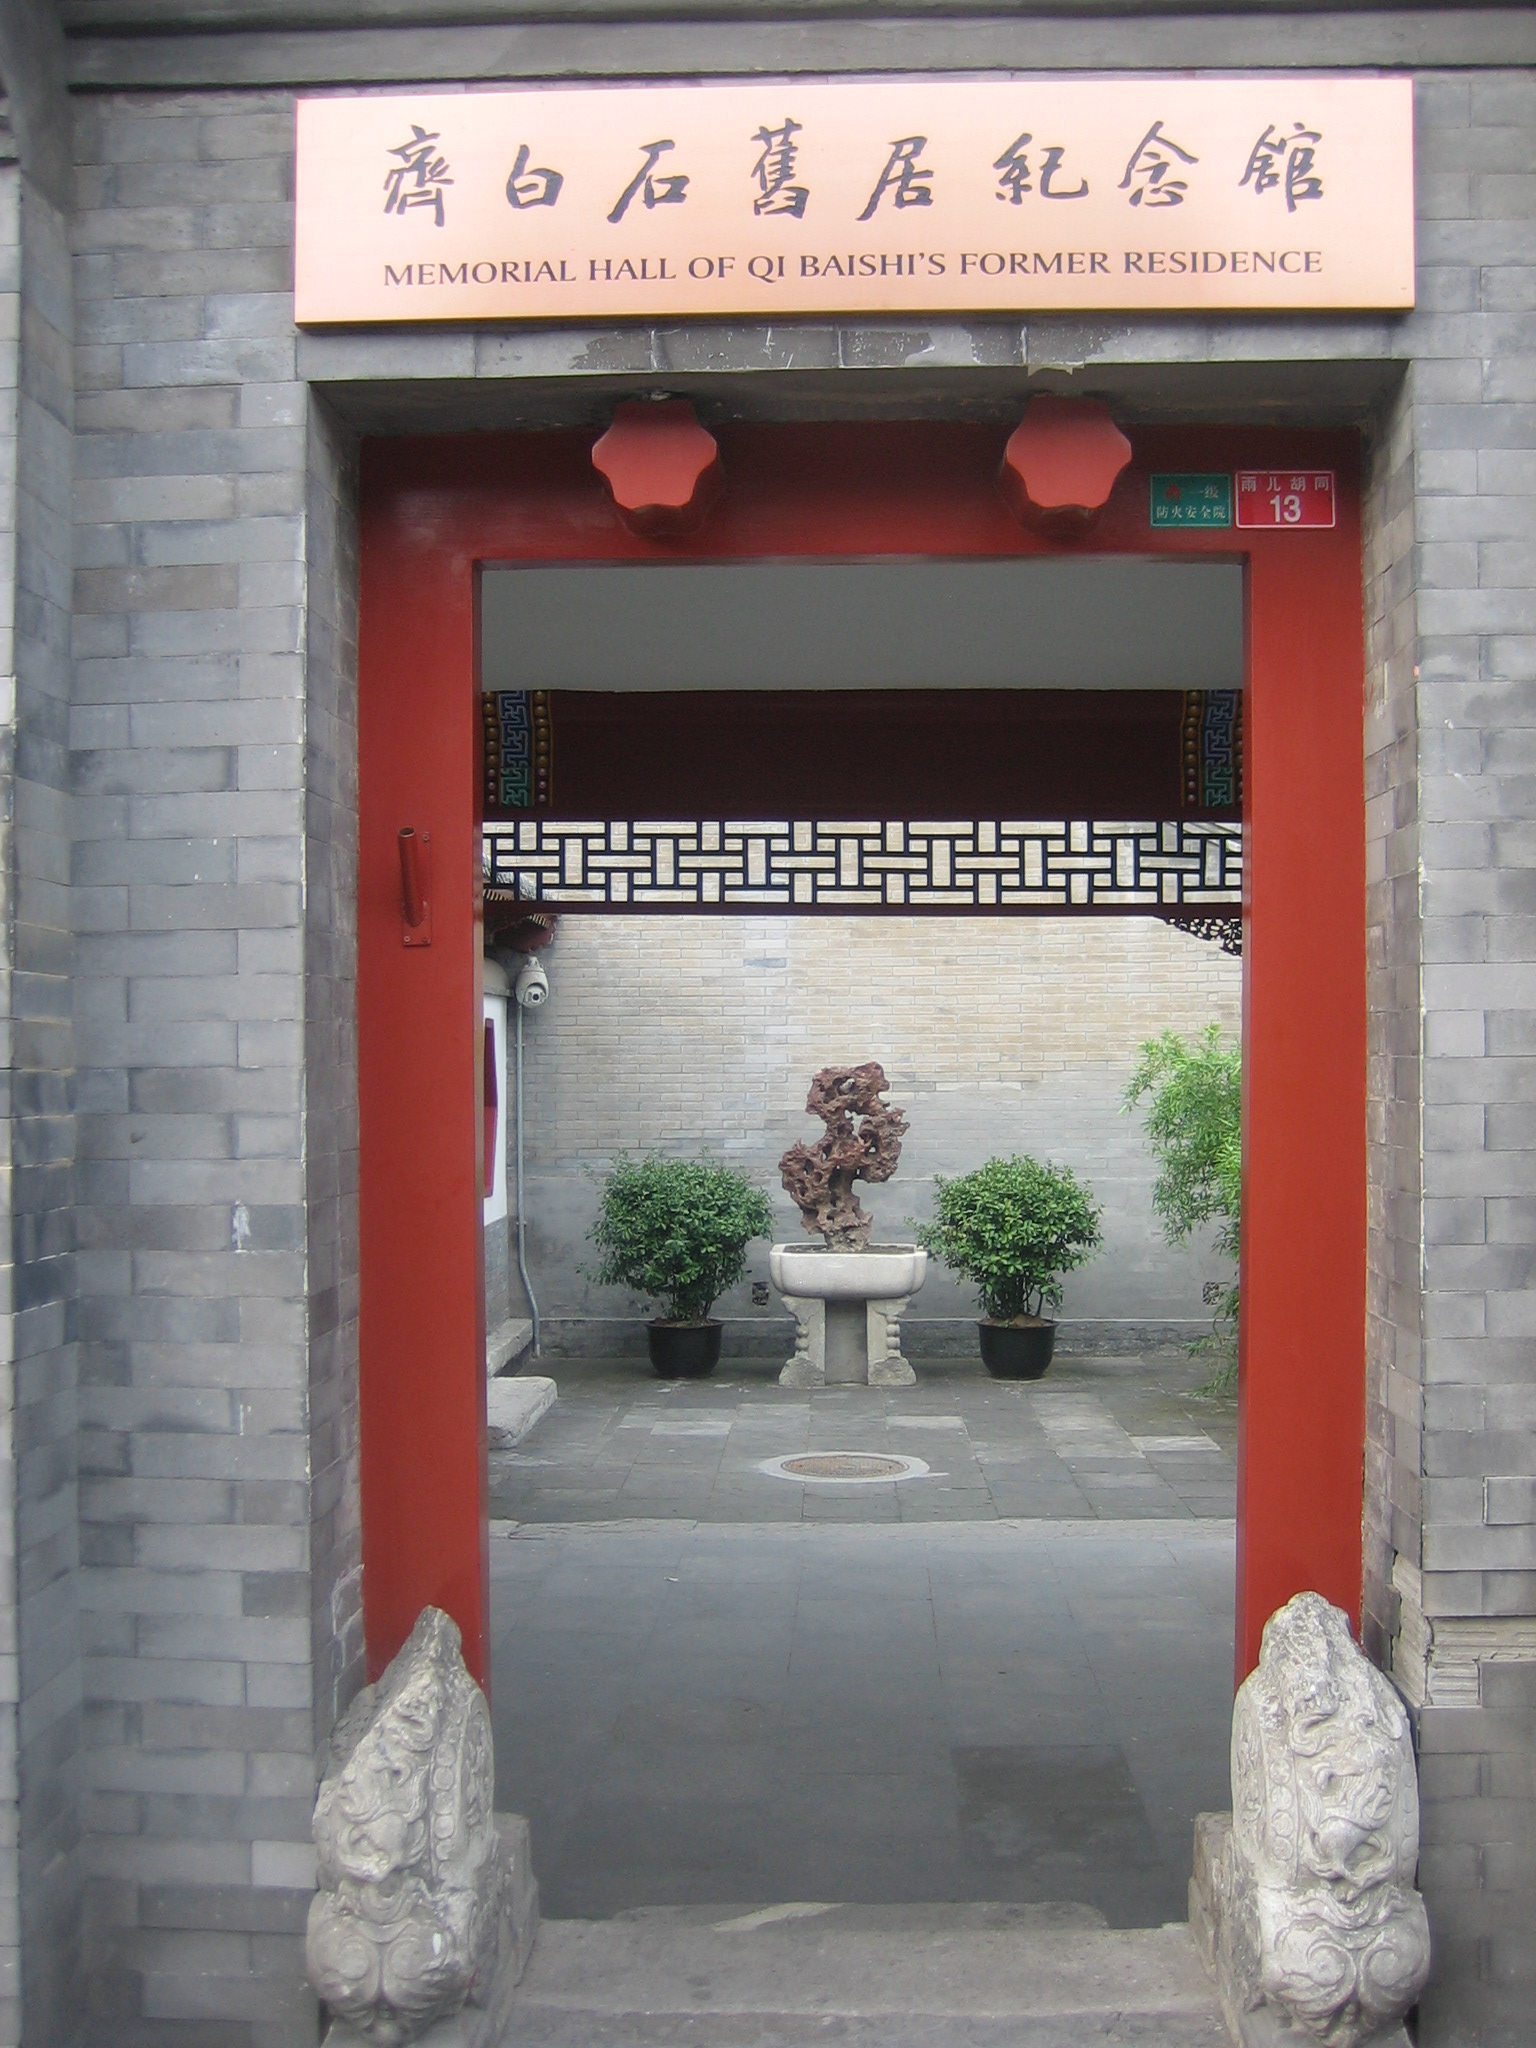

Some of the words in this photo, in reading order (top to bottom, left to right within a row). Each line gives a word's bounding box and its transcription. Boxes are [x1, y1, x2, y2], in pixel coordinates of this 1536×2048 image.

[384, 260, 576, 286] MEMORIAL
[587, 258, 677, 282] HALL
[687, 256, 736, 280] OF
[747, 255, 786, 284] QI
[798, 252, 946, 278] BAISHI'S
[960, 251, 1111, 275] FORMER
[1122, 250, 1323, 274] RESIDENCE
[1241, 476, 1330, 493] 雨儿胡同
[1156, 504, 1226, 519] 防火安全院
[1269, 494, 1301, 523] 13
